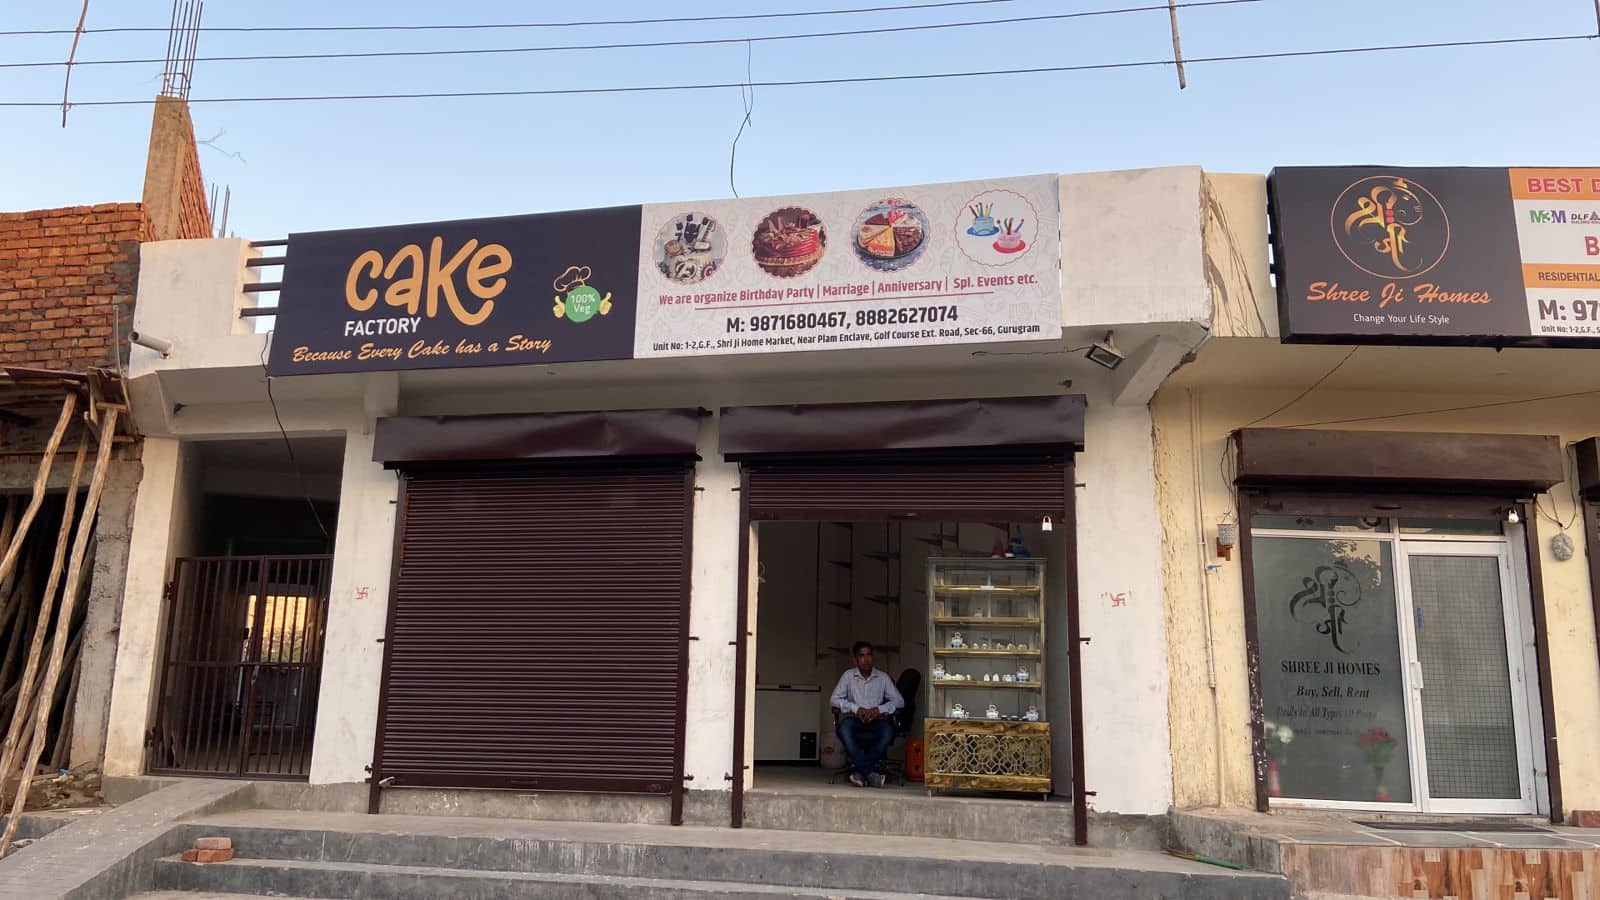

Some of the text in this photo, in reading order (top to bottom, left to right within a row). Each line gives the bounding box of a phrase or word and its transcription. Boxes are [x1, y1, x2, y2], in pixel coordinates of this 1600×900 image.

[1527, 178, 1583, 193] BEST
[1538, 272, 1600, 282] RESIDENTIAL
[660, 273, 1038, 305] We are organize Birthday Party Marriage Anniversary Spl. Events etc.
[1307, 281, 1492, 309] Shree Ji Homes
[571, 293, 596, 304] 100%
[573, 303, 592, 316] Veg
[1538, 299, 1600, 321] M: 97
[344, 316, 421, 337] FACTORY
[726, 305, 958, 333] M: 9871680467, 8882627074
[1353, 313, 1450, 326] Change Your Life Style
[653, 341, 669, 351] Unit
[670, 341, 684, 351] No:
[716, 338, 732, 349] Shri
[733, 338, 741, 349] Ji
[741, 337, 764, 348] Home
[765, 335, 796, 347] Market,
[797, 334, 816, 345] Near
[817, 333, 838, 344] Plam
[839, 331, 873, 343] Enclave,
[874, 330, 890, 341] Golf
[891, 328, 920, 340] Course
[921, 327, 938, 339] Ext.
[939, 326, 962, 338] Road,
[964, 325, 996, 337] Sec-66,
[997, 323, 1041, 335] Gurugram
[293, 334, 552, 362] Because Every Cake has a Story
[1281, 660, 1381, 676] SHREE JI HOMES
[1346, 686, 1369, 699] Rent
